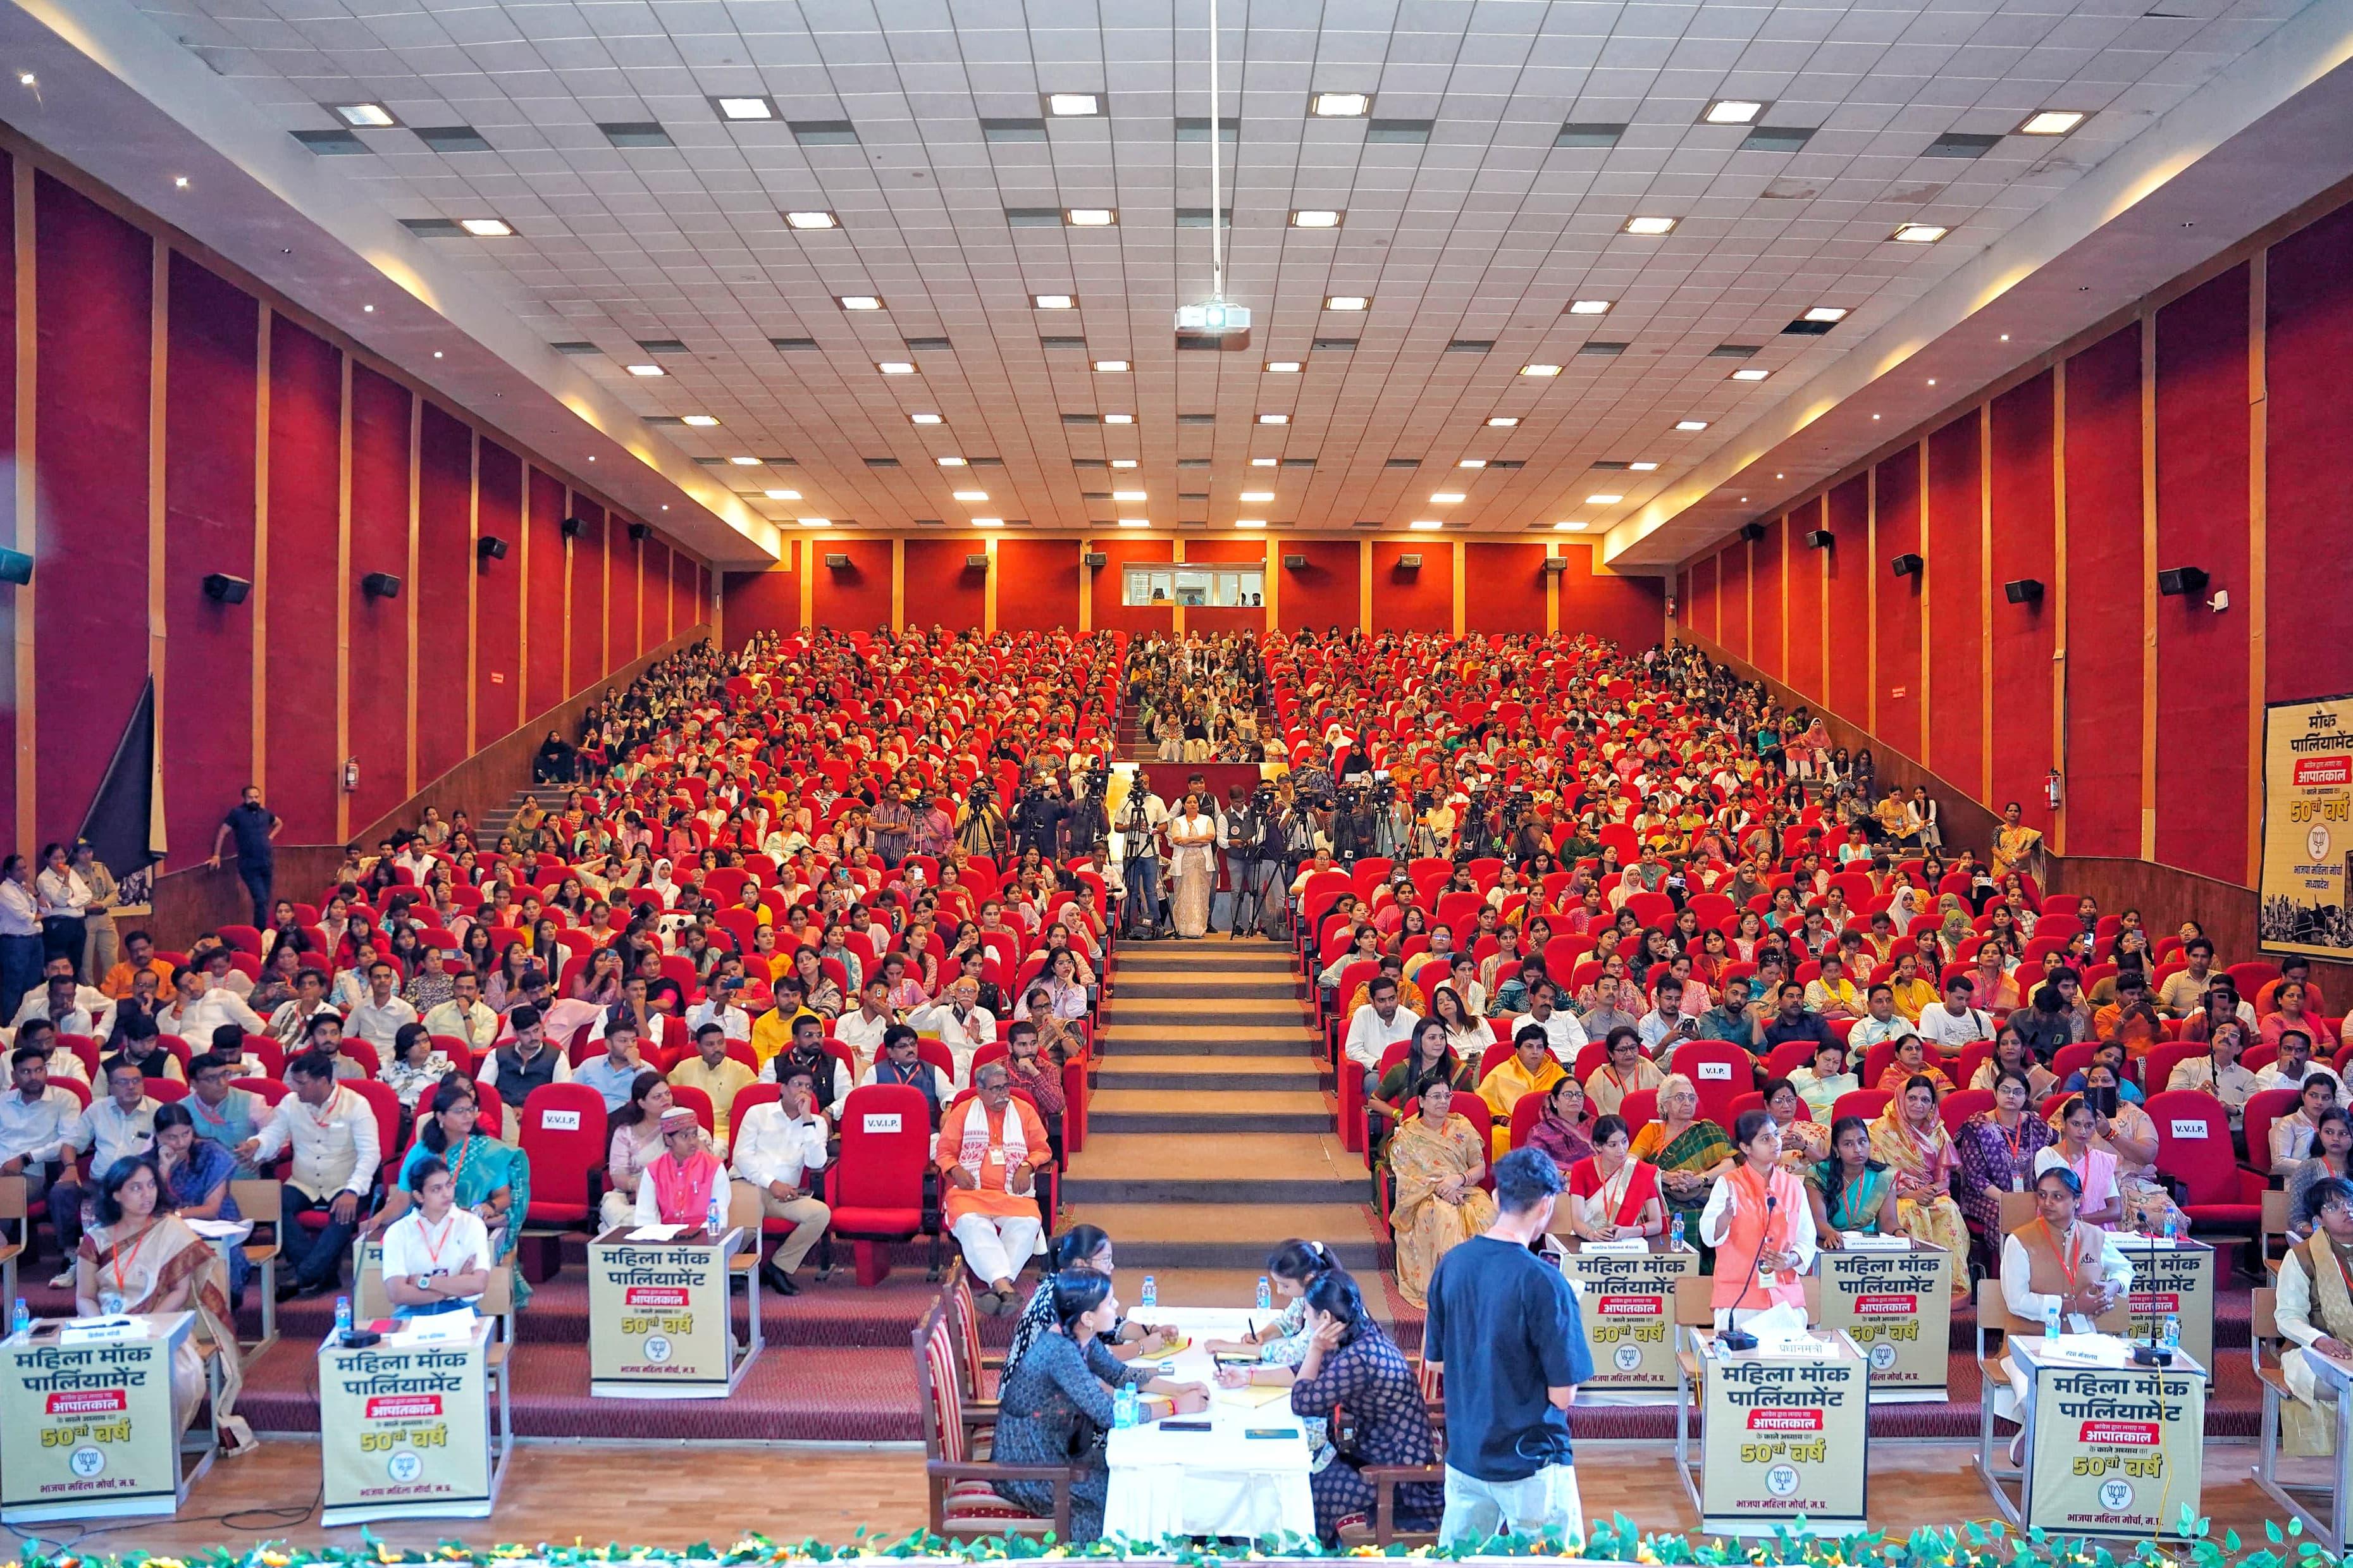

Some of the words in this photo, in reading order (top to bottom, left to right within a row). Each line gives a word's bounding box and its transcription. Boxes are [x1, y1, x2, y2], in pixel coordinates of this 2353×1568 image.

[2309, 710, 2337, 729] मॉक
[2299, 769, 2346, 783] आपातकाल
[2324, 792, 2350, 822] वर्ष
[2294, 866, 2311, 876] भाजपा
[2311, 864, 2328, 875] महिला
[2330, 863, 2343, 875] मोर्चा
[547, 1115, 576, 1125] V.V.I.P.
[868, 1120, 898, 1128] V.V.I.P.
[602, 1248, 663, 1266] महिला
[667, 1248, 710, 1264] मॉक
[1576, 1256, 1639, 1276] महिला
[1643, 1256, 1686, 1273] मॉक
[1834, 1256, 1894, 1275] महिला
[1898, 1254, 1940, 1272] मॉक
[2160, 1254, 2201, 1270] मॉक
[608, 1268, 705, 1286] पार्लियामेंट
[1839, 1276, 1934, 1293] पार्लियामेंट
[1604, 1304, 1656, 1313] आपातकाल
[1860, 1304, 1911, 1312] आपातकाल
[1634, 1321, 1664, 1342] वर्ष
[1889, 1319, 1919, 1342] वर्ष
[15, 1347, 93, 1369] महिला
[98, 1343, 152, 1363] मॉक
[335, 1352, 411, 1373] महिला
[416, 1348, 468, 1367] मॉक
[22, 1367, 147, 1392] पार्लियामेंट
[1610, 1374, 1631, 1382] महिला
[1722, 1362, 1794, 1385] महिला
[1800, 1362, 1851, 1382] मॉक
[343, 1372, 462, 1395] पार्लियामेंट
[2054, 1373, 2130, 1396] महिला
[2135, 1375, 2189, 1396] मॉक
[52, 1399, 119, 1412] आपातकाल
[1727, 1386, 1844, 1407] पार्लियामेंट
[2059, 1398, 2182, 1421] पार्लियामेंट
[93, 1417, 132, 1443] वर्ष
[1754, 1419, 1817, 1428] आपातकाल
[2086, 1431, 2152, 1442] आपातकाल
[1790, 1438, 1826, 1462] वर्ष
[2124, 1453, 2163, 1478] वर्ष
[68, 1481, 94, 1491] महिला
[1737, 1500, 1760, 1508] भाजपा
[1762, 1499, 1787, 1508] महिला
[2094, 1513, 2120, 1523] महिला
